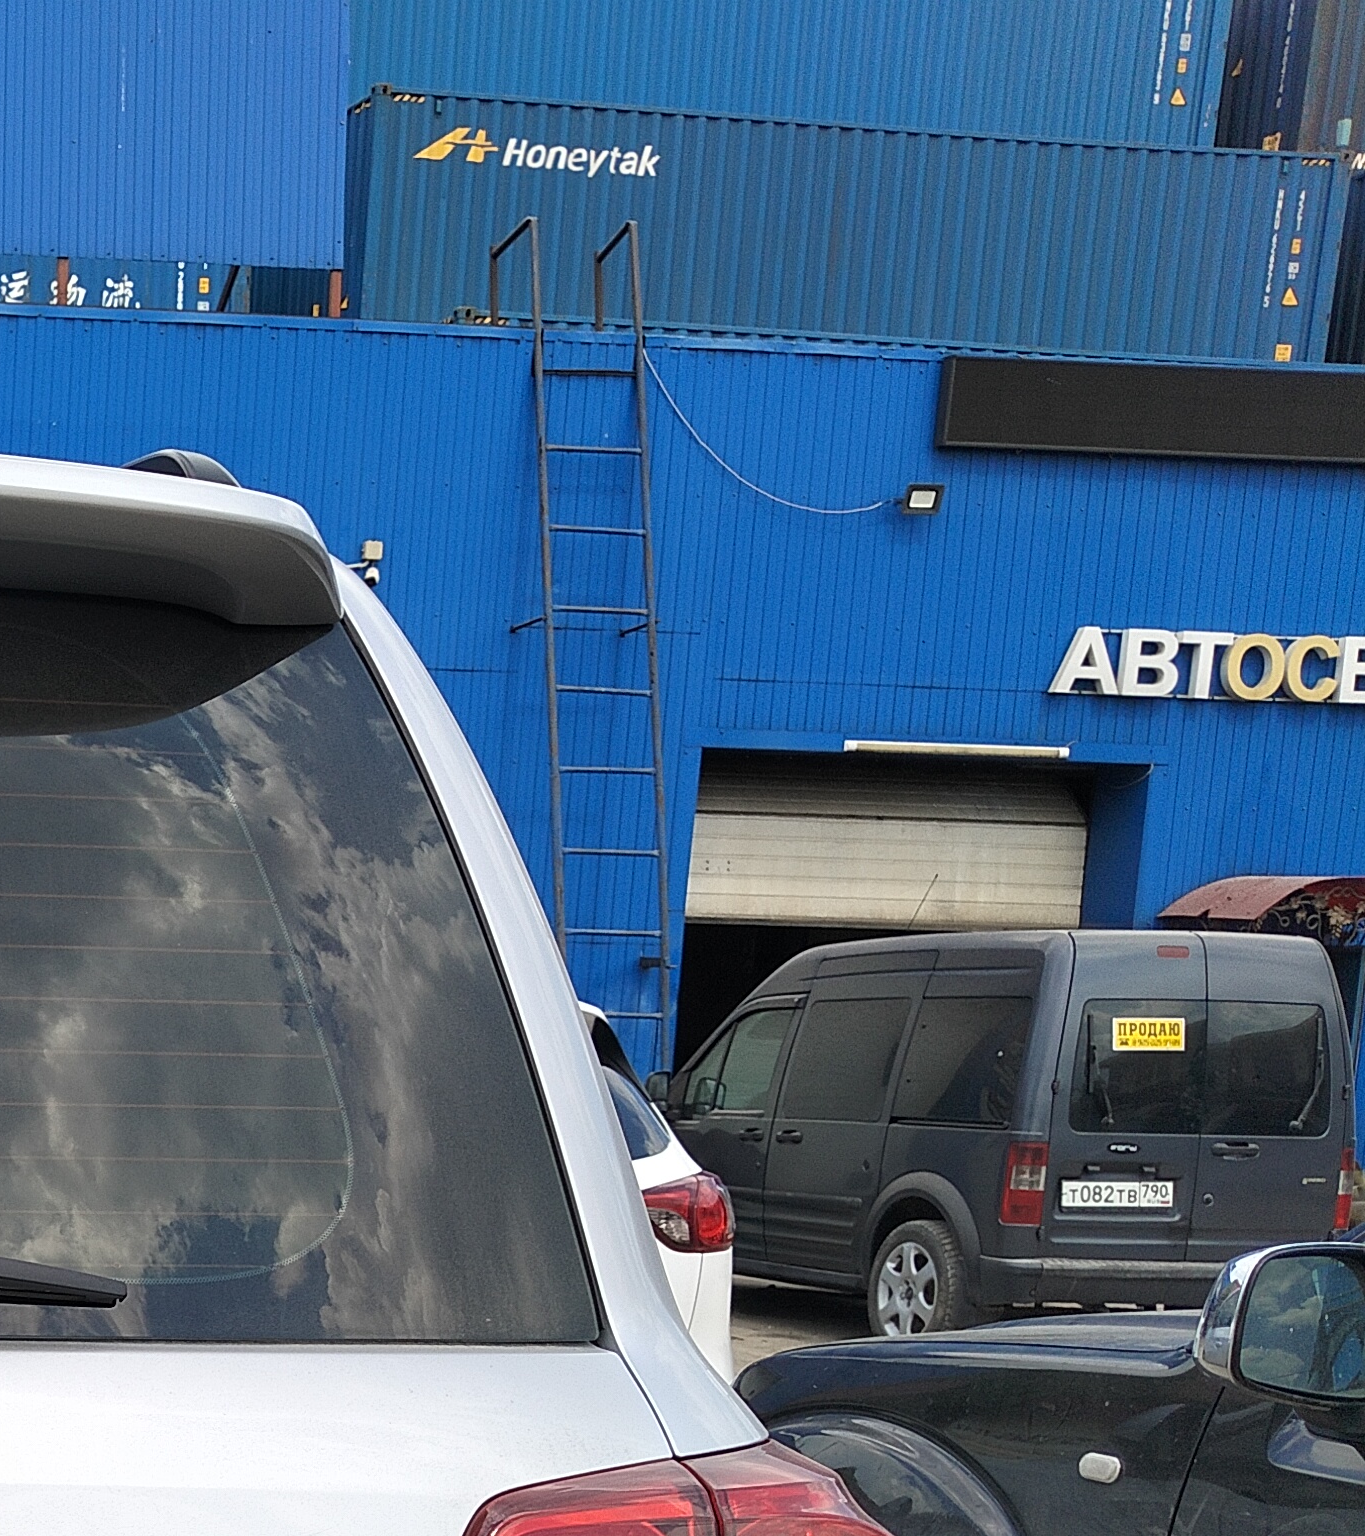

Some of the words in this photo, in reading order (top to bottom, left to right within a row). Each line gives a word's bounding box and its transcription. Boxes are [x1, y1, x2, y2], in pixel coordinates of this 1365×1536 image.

[502, 137, 662, 178] Honeytak
[1118, 1022, 1181, 1039] ПРОДАЮ
[1141, 1184, 1169, 1199] 790
